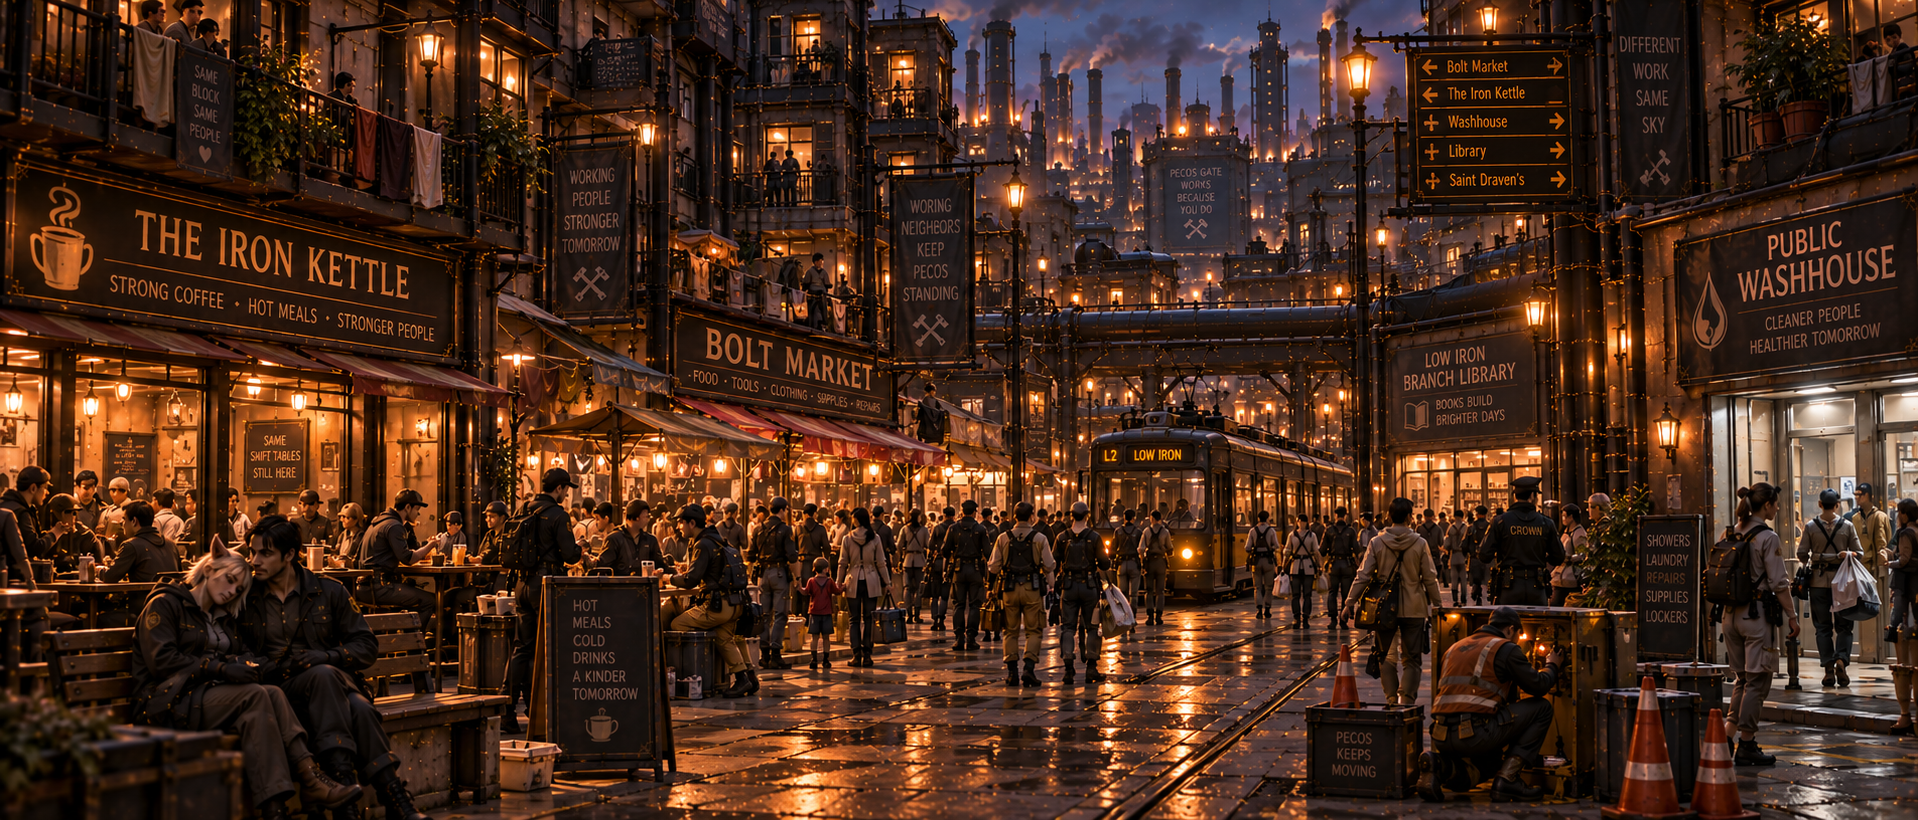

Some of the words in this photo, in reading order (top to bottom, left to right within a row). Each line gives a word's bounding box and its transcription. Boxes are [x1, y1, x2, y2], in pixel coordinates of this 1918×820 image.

[1620, 36, 1680, 53] DIFFERENT
[1448, 60, 1468, 73] Bolt
[1471, 60, 1508, 72] Market
[1633, 63, 1669, 79] WORK
[195, 65, 218, 84] SAME
[192, 83, 219, 104] BLOCK
[1448, 87, 1466, 100] The
[1471, 87, 1491, 99] Iron
[1496, 86, 1525, 99] Kettle
[1636, 90, 1668, 106] SAME
[194, 104, 217, 123] SAME
[1448, 115, 1507, 128] Washhouse
[1643, 117, 1665, 133] SKY
[190, 123, 220, 144] PEOPLE
[1449, 144, 1486, 160] Library
[570, 168, 614, 184] WORKING
[1171, 168, 1197, 177] PECOS
[1200, 168, 1221, 176] GATE
[1450, 173, 1476, 186] Saint
[1481, 173, 1524, 186] Draven's
[573, 190, 610, 206] PEOPLE
[1178, 193, 1215, 202] BECAUSE
[910, 198, 951, 213] WORING
[1181, 206, 1197, 214] YOU
[1201, 205, 1212, 214] DO
[565, 213, 618, 230] STRONGER
[562, 236, 620, 253] TOMORROW
[1766, 221, 1843, 261] PUBLIC
[135, 210, 202, 260] THE
[219, 228, 293, 277] IRON
[307, 247, 410, 299] KETTLE
[918, 242, 944, 257] KEEP
[914, 264, 948, 279] PECOS
[1738, 244, 1895, 302] WASHHOUSE
[903, 286, 958, 301] STANDING
[110, 275, 168, 300] STRONG
[175, 286, 223, 309] COFFEE
[249, 298, 273, 316] HOT
[279, 303, 317, 323] MEALS
[338, 313, 393, 335] STRONGER
[399, 322, 434, 342] PEOPLE
[1766, 310, 1813, 330] CLEANER
[1819, 303, 1860, 323] PEOPLE
[1750, 333, 1807, 354] HEALTHIER
[1812, 323, 1880, 349] TOMORROW
[706, 327, 774, 370] BOLT
[786, 347, 874, 390] MARKET
[1426, 351, 1450, 368] LOW
[1456, 346, 1485, 364] IRON
[1404, 370, 1453, 391] BRANCH
[1460, 362, 1515, 385] LIBRARY
[694, 370, 718, 385] FOOD
[731, 377, 759, 392] TOOLS
[771, 384, 807, 400] CLOTHING
[1436, 397, 1464, 410] BOOKS
[1468, 395, 1492, 407] BUILD
[1436, 412, 1478, 425] BRIGHTER
[1482, 409, 1505, 422] DAYS
[264, 435, 286, 446] SAME
[1105, 450, 1117, 461] L2
[1134, 449, 1155, 461] LOW
[1159, 449, 1181, 460] IRON
[254, 468, 272, 478] STILL
[276, 467, 296, 478] HERE
[1510, 526, 1542, 535] CROWN
[1647, 534, 1690, 547] SHOWERS
[1646, 554, 1688, 566] LAUNDRY
[1647, 572, 1685, 584] REPAIRS
[1646, 590, 1688, 603] SUPPLIES
[574, 600, 598, 611] HOT
[573, 617, 611, 628] MEALS
[1646, 610, 1687, 623] LOCKERS
[573, 635, 605, 646] COLD
[573, 652, 615, 664] DRINKS
[573, 671, 580, 682] A
[586, 670, 625, 682] KINDER
[573, 688, 638, 700] TOMORROW
[1337, 730, 1372, 744] PECOS
[1337, 748, 1371, 761] KEEPS
[1332, 764, 1376, 777] MOVING
